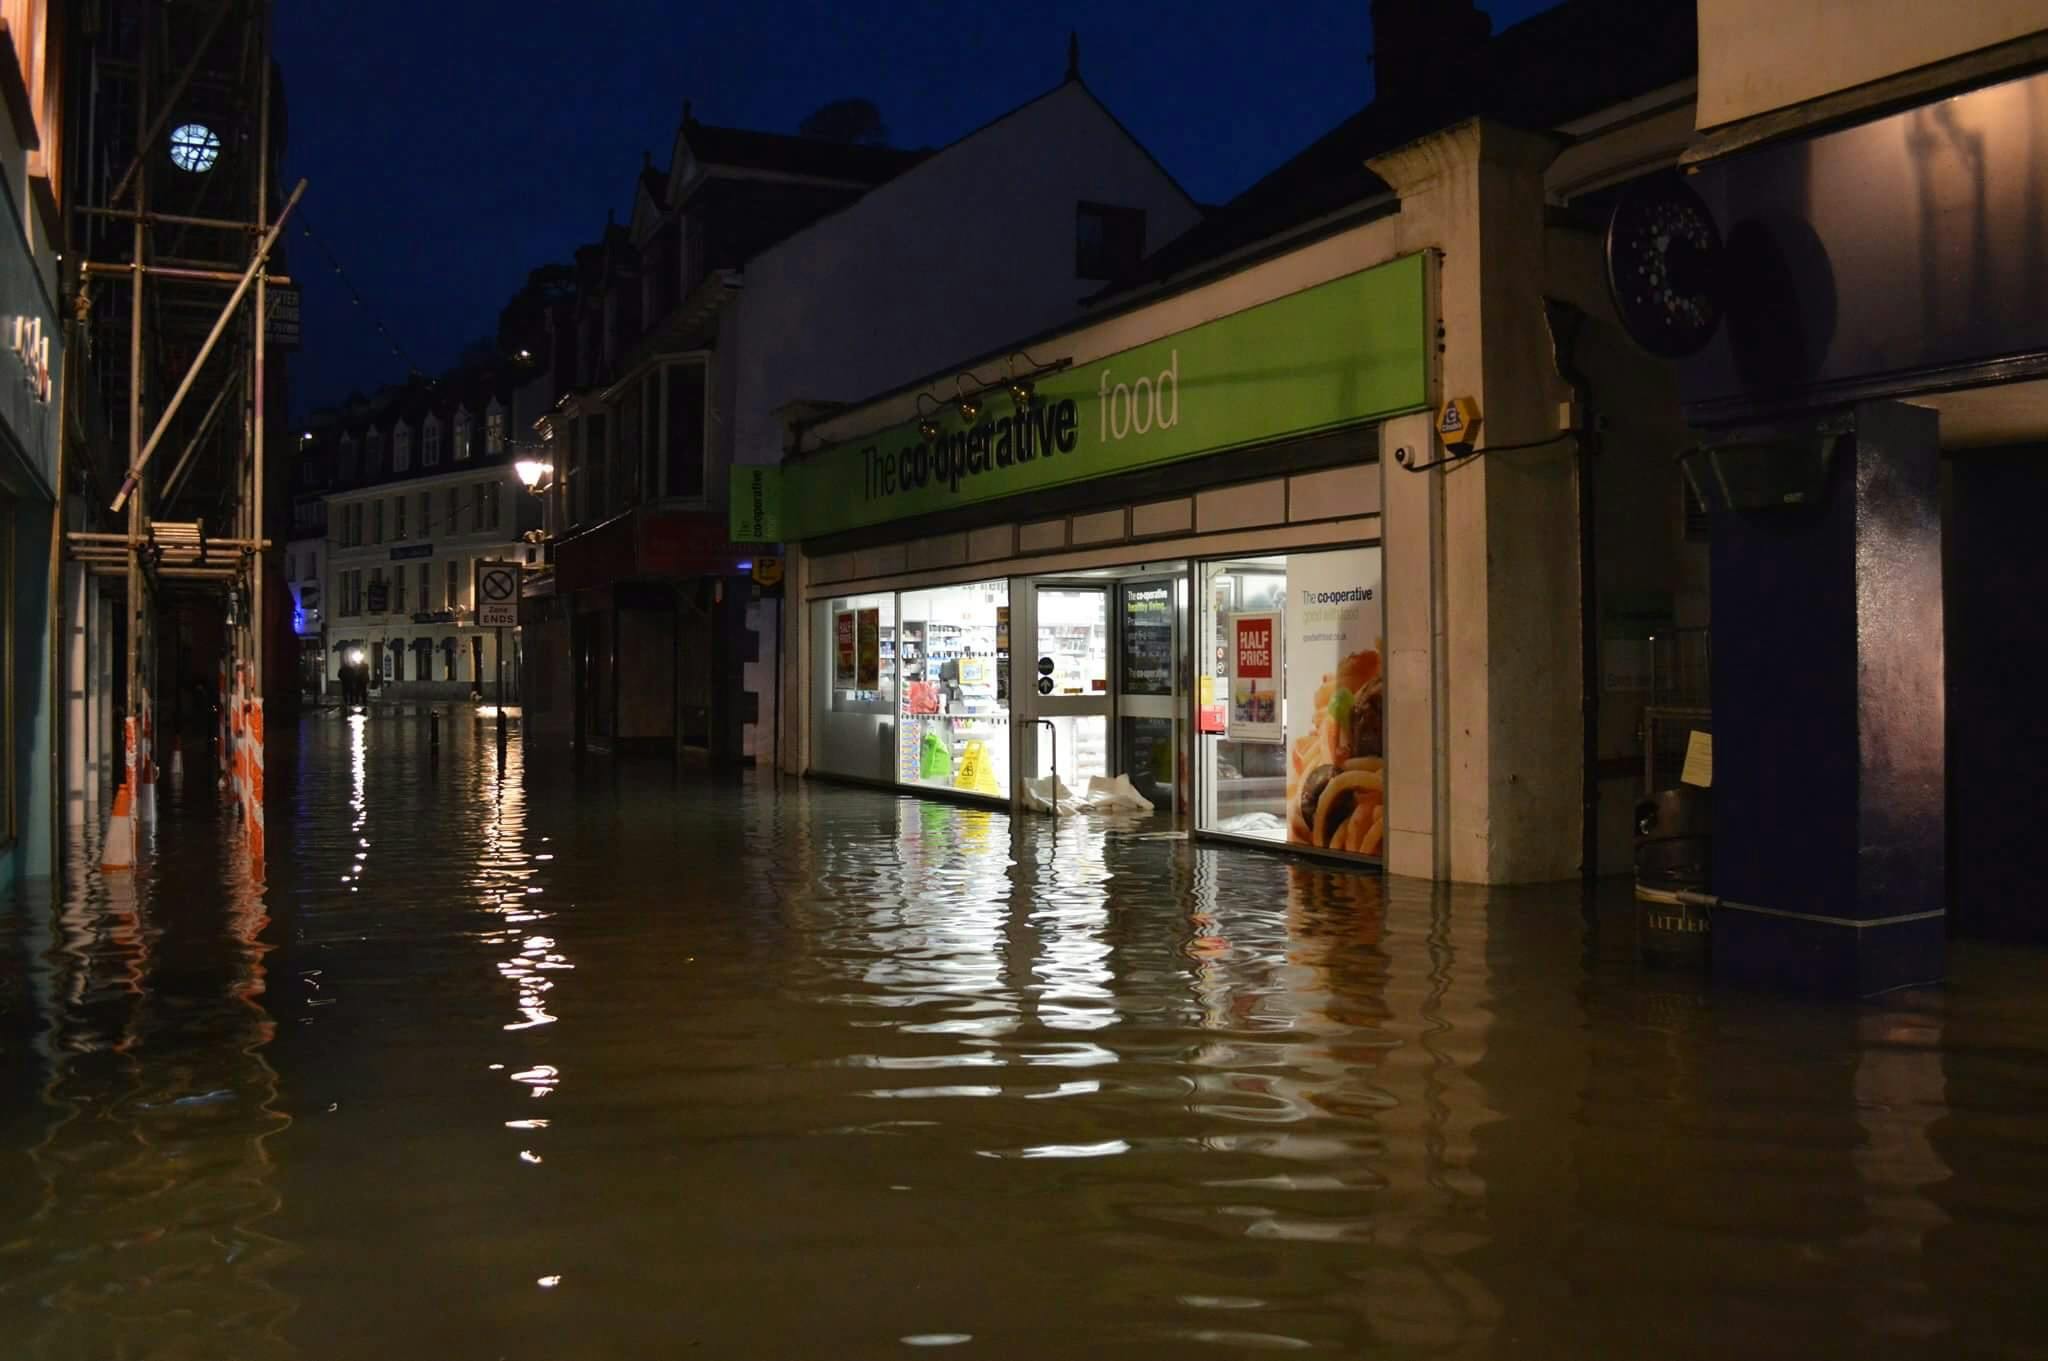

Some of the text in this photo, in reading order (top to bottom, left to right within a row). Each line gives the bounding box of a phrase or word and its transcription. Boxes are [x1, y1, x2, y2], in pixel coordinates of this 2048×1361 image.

[861, 348, 1179, 500] The co-operative food
[1302, 586, 1373, 606] The co-operative
[483, 614, 514, 624] ENDS
[488, 606, 508, 614] Zone
[1240, 630, 1269, 649] HALF
[1240, 649, 1270, 667] PRICE
